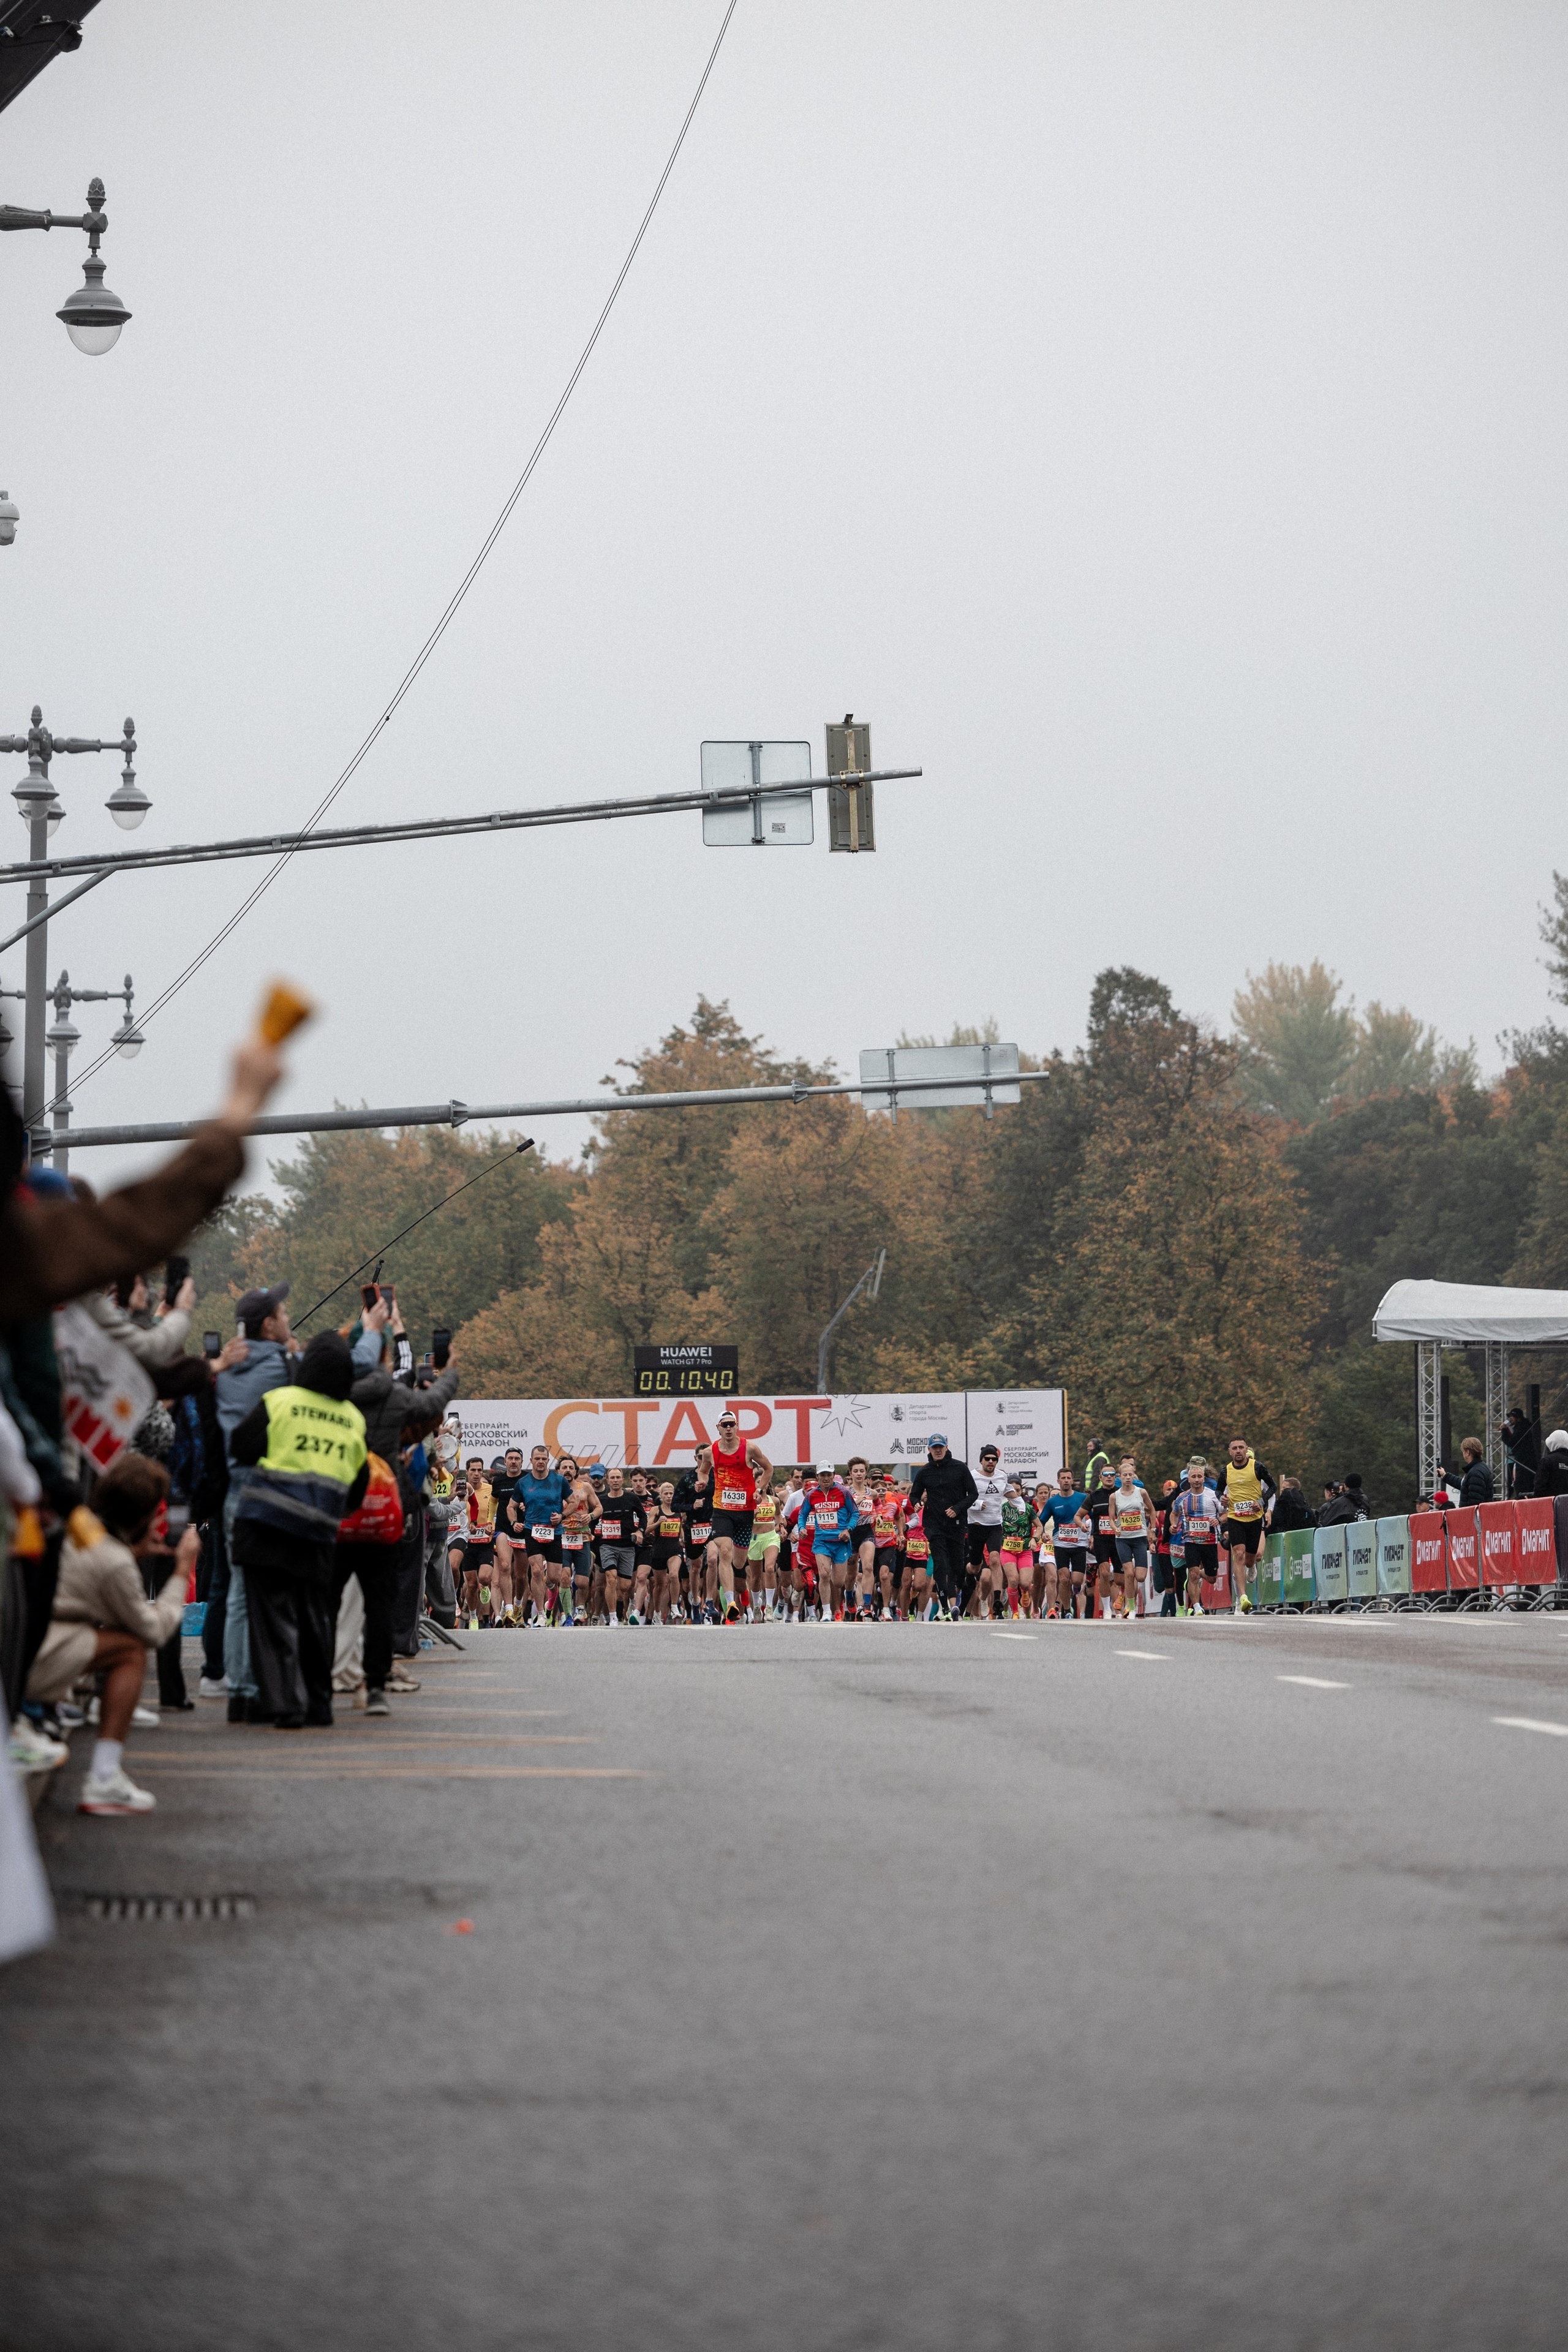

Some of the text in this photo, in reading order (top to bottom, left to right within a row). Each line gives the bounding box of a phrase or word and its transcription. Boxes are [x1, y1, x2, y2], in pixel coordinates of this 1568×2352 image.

[660, 1347, 712, 1357] HUAWEI
[290, 1406, 352, 1429] STEWARD
[543, 1398, 832, 1466] СТАРТ
[296, 1434, 346, 1460] 2371
